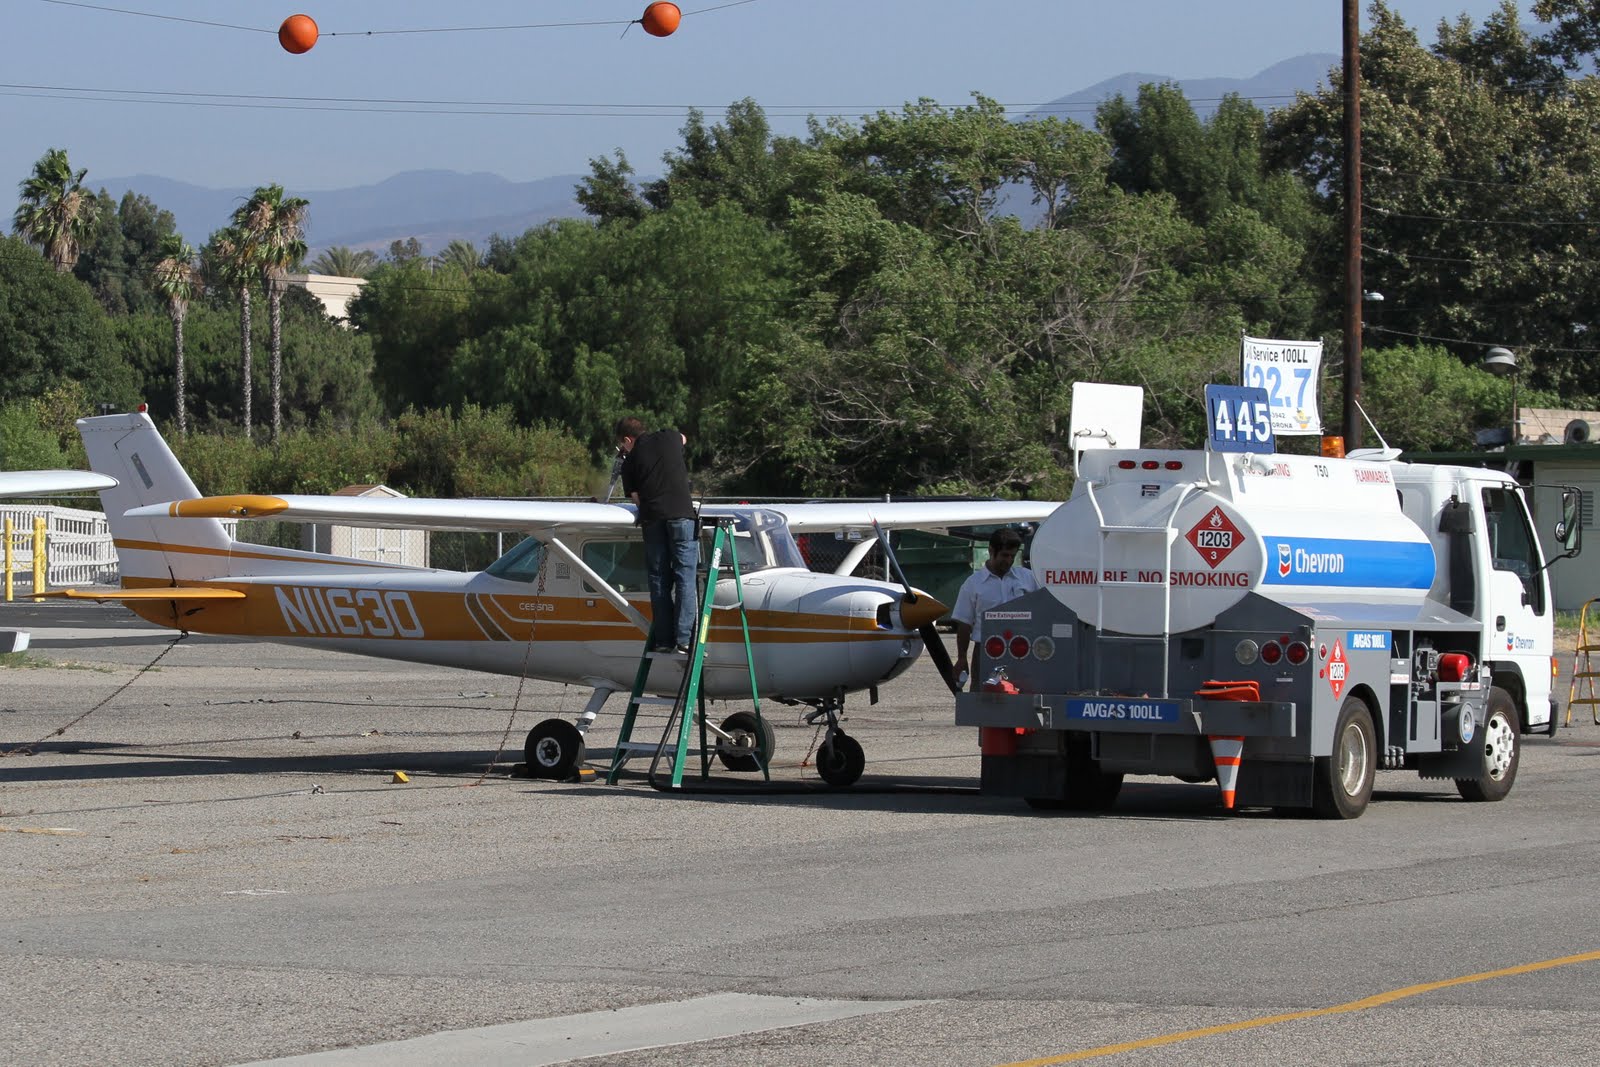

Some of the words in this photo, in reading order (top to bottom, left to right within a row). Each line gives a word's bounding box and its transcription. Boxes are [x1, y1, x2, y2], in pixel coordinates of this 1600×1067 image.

[1253, 346, 1279, 362] Service
[1281, 348, 1308, 364] 100LL
[1215, 400, 1271, 442] 4.45
[1314, 464, 1329, 478] 750
[1354, 469, 1390, 483] FLAMMABLE
[1199, 531, 1231, 547] 1203
[1210, 551, 1217, 560] 3
[1295, 548, 1344, 573] Chevron
[1138, 571, 1163, 583] NO
[1170, 571, 1249, 587] SMOKING
[274, 586, 424, 638] N11630
[1353, 633, 1371, 648] AVGAS
[1331, 664, 1344, 678] 1203
[1082, 702, 1126, 718] AVGAS
[1128, 705, 1163, 720] 100LL
